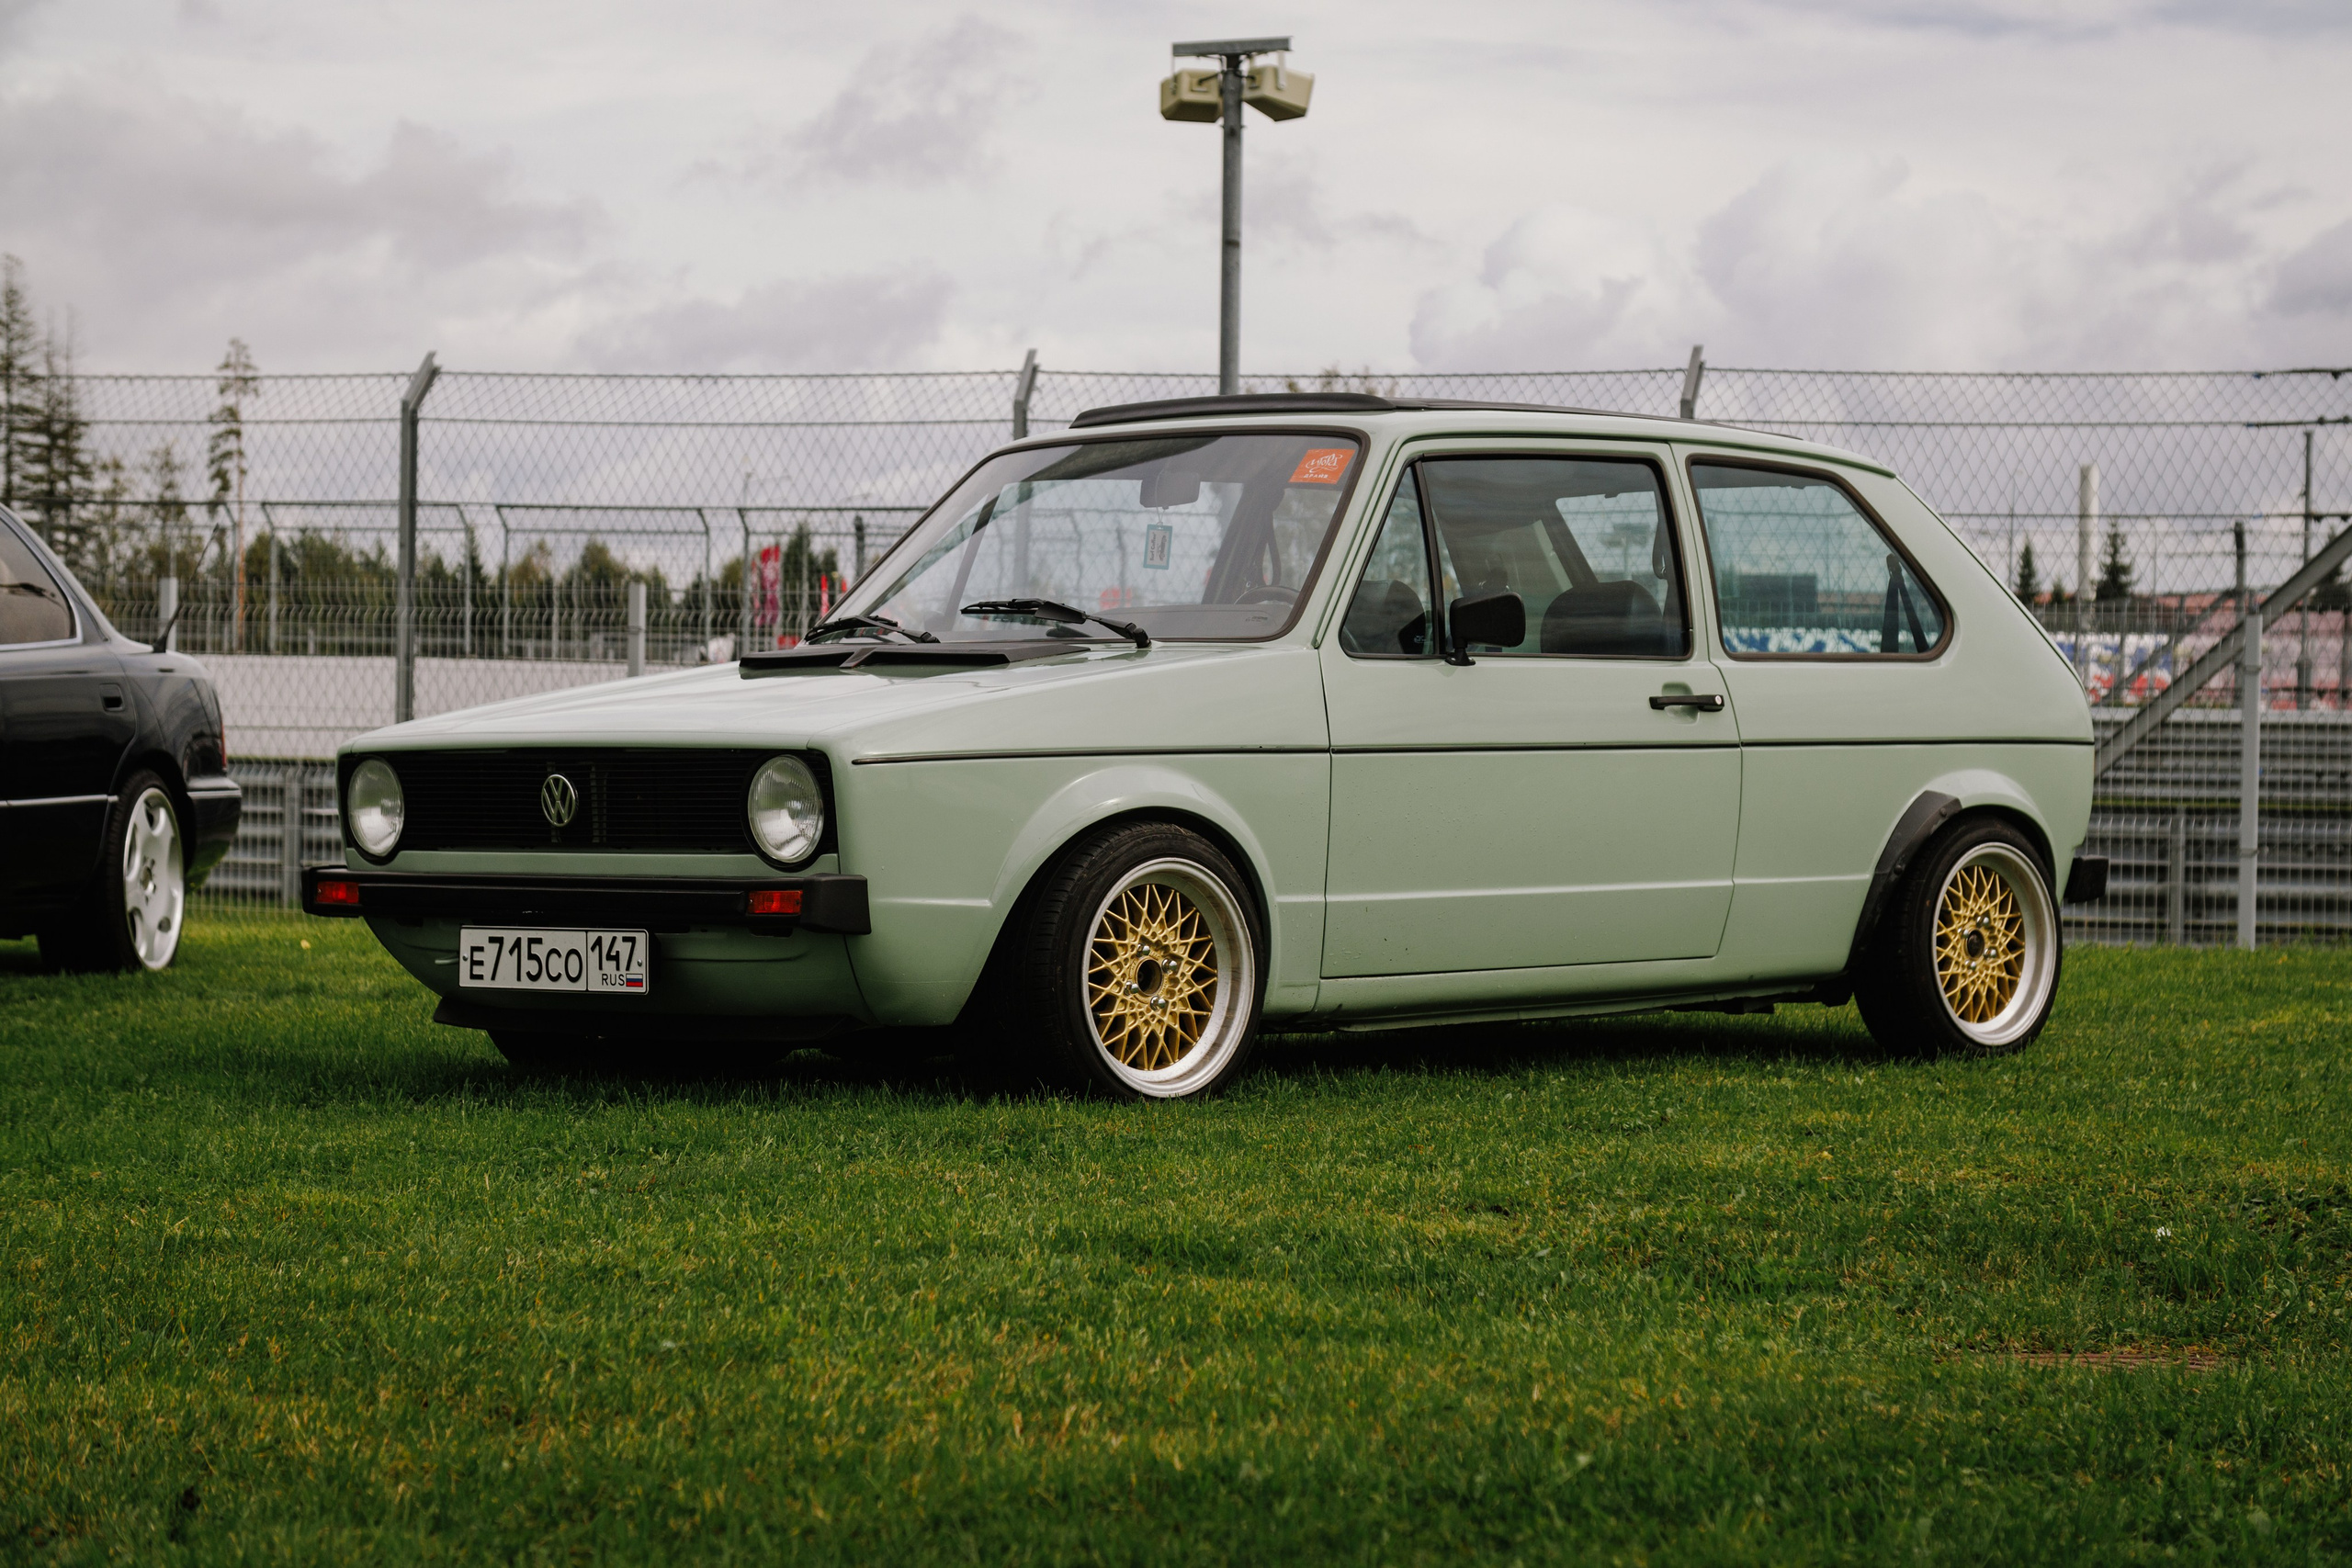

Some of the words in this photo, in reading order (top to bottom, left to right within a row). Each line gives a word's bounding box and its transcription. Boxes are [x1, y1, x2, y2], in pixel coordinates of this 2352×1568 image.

[469, 935, 583, 983] E715CO
[590, 935, 637, 972] 147
[601, 973, 625, 987] RUS
